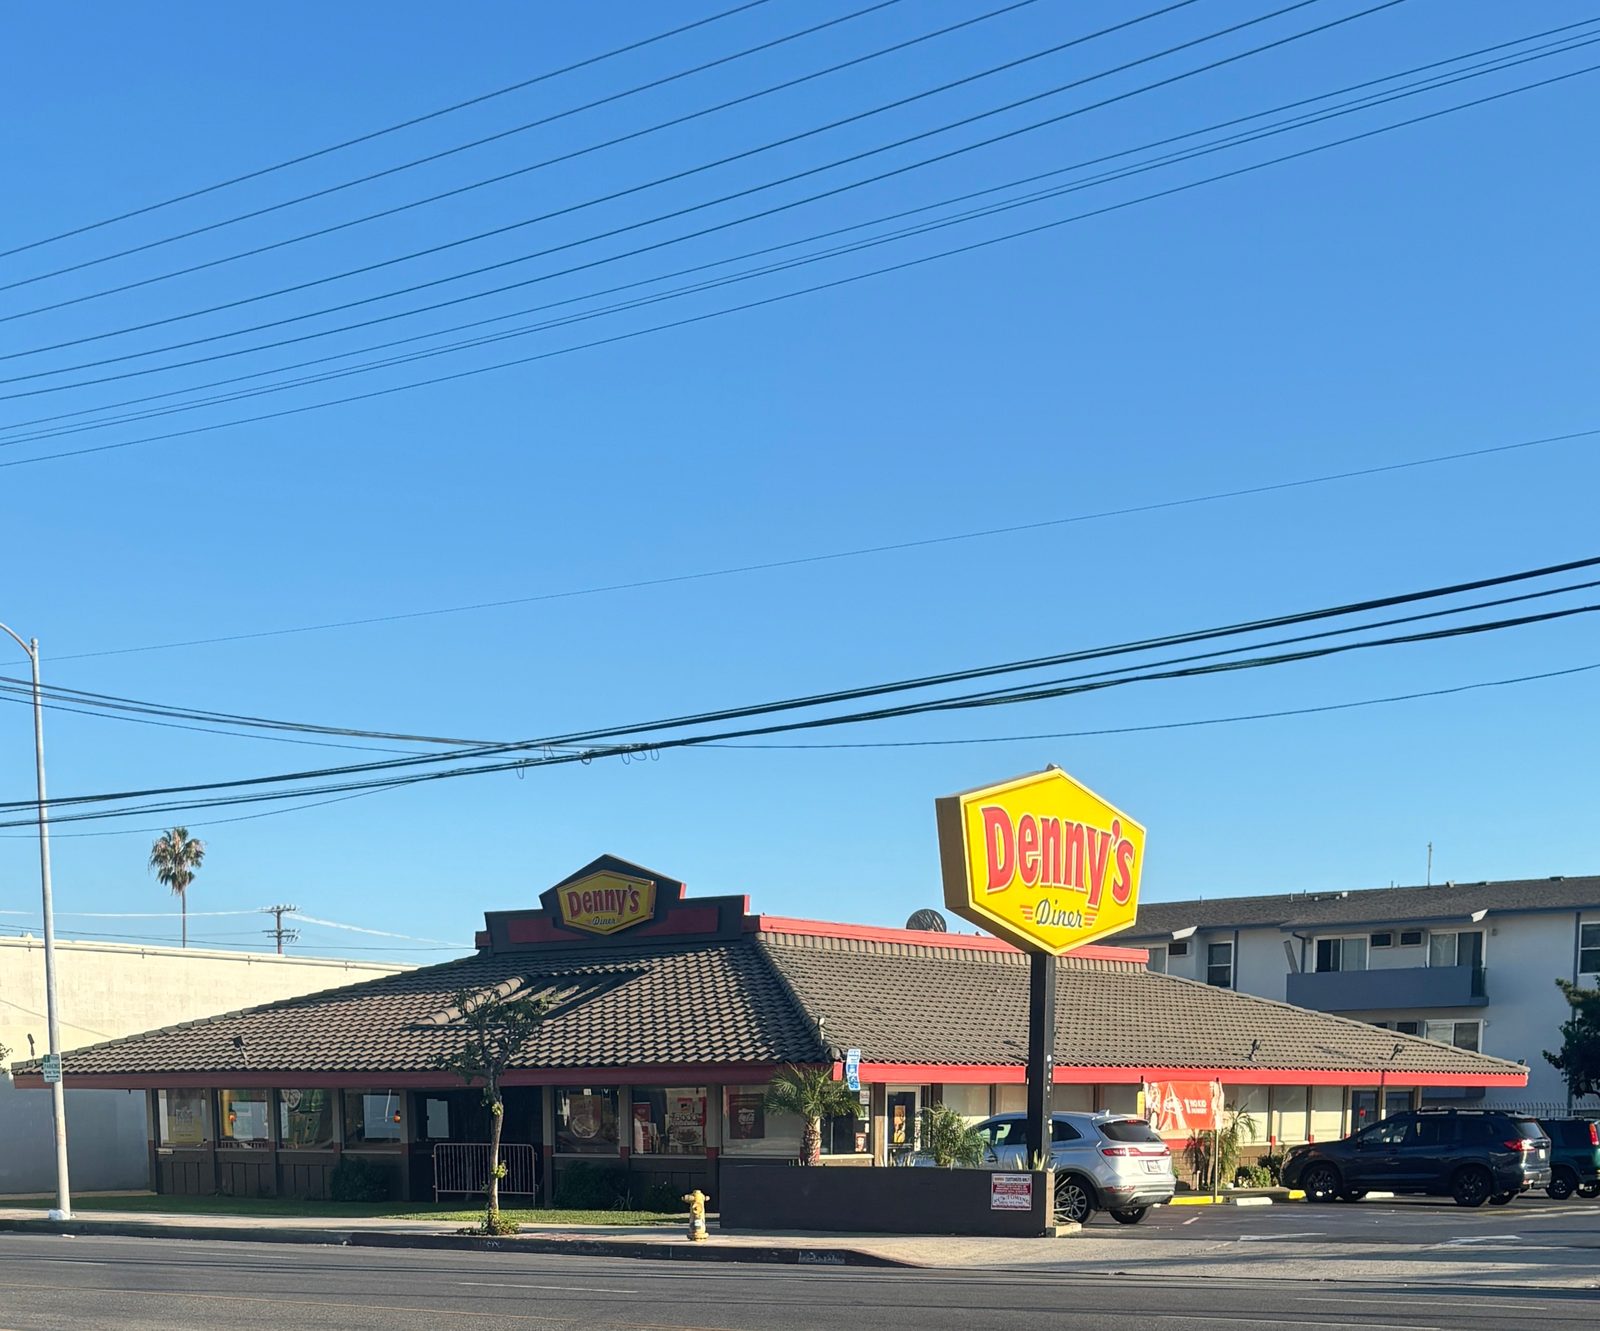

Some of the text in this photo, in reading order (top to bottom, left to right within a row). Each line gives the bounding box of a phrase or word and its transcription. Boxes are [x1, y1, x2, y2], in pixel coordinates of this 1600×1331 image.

[981, 807, 1135, 909] Denny's
[567, 884, 640, 917] Denny's
[1035, 899, 1083, 928] Diner
